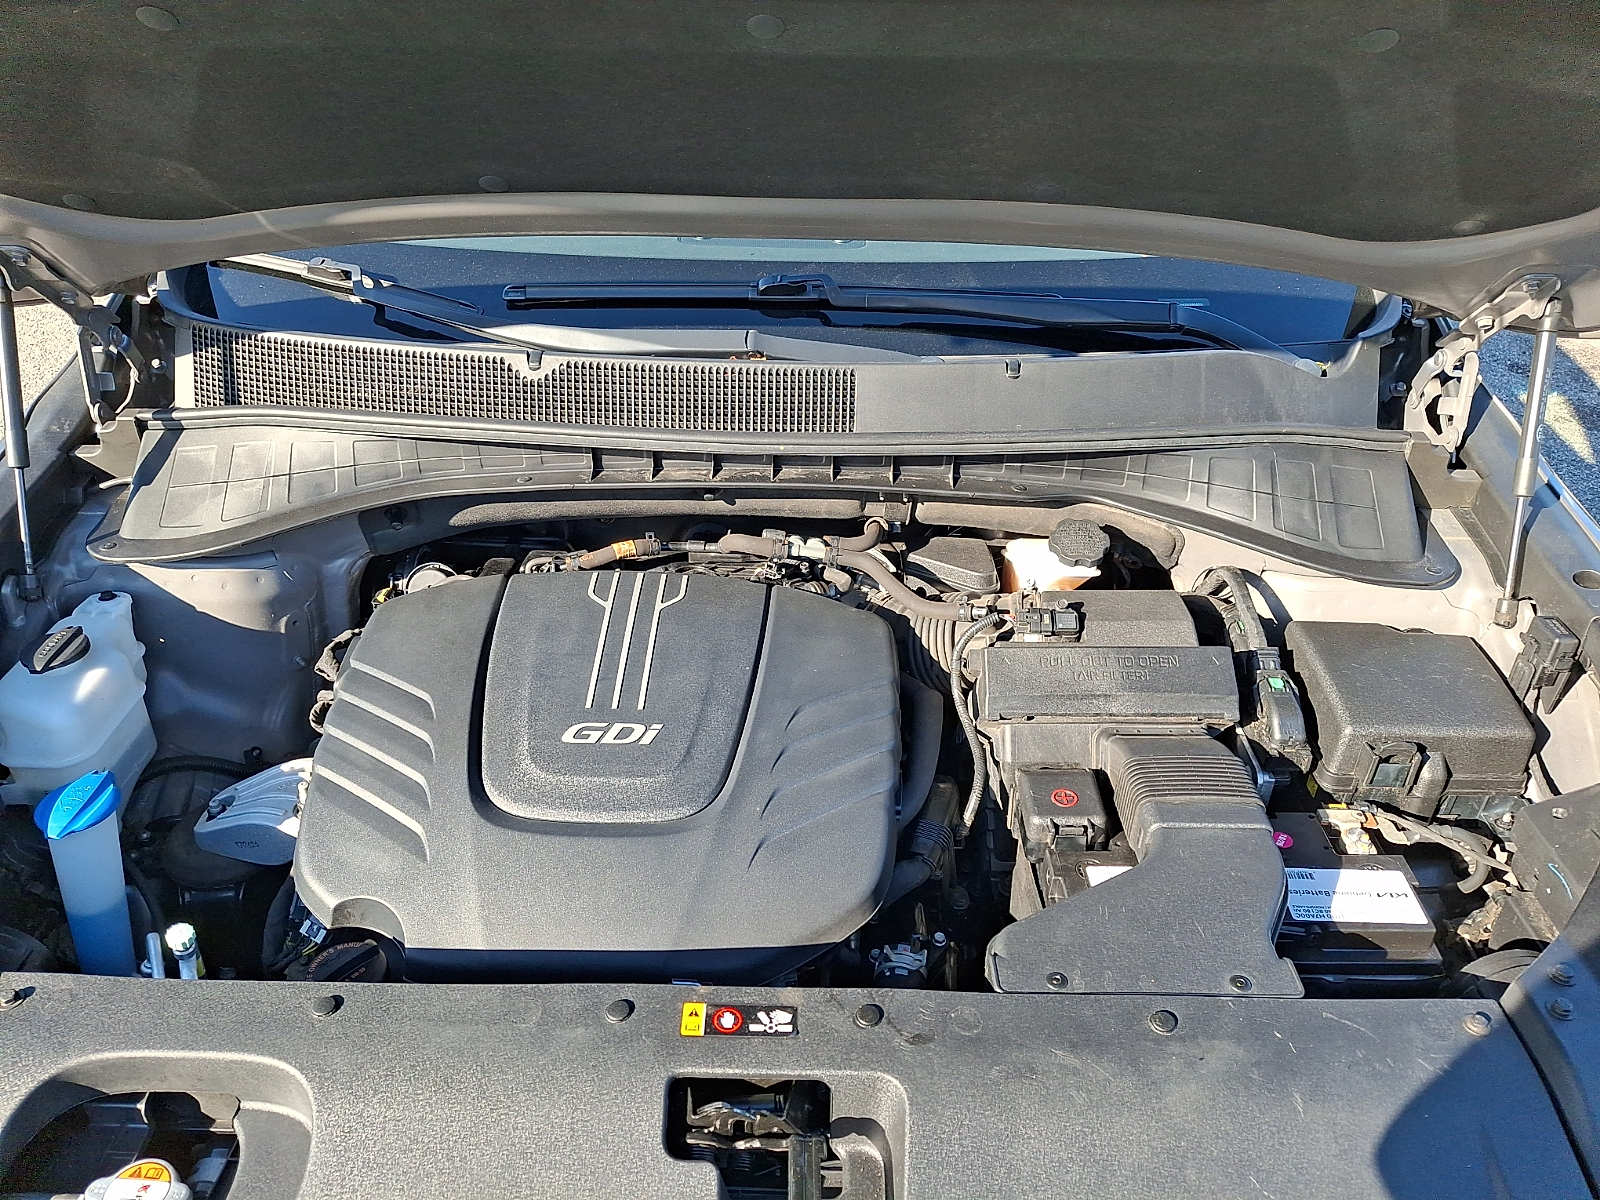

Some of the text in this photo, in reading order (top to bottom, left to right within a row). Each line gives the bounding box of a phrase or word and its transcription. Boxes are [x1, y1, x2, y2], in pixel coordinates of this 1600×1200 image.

[1040, 655, 1180, 668] PULL OUT TO OPEN
[561, 722, 665, 746] GDi
[1288, 889, 1331, 897] Batteries
[308, 948, 335, 972] OWNER'S
